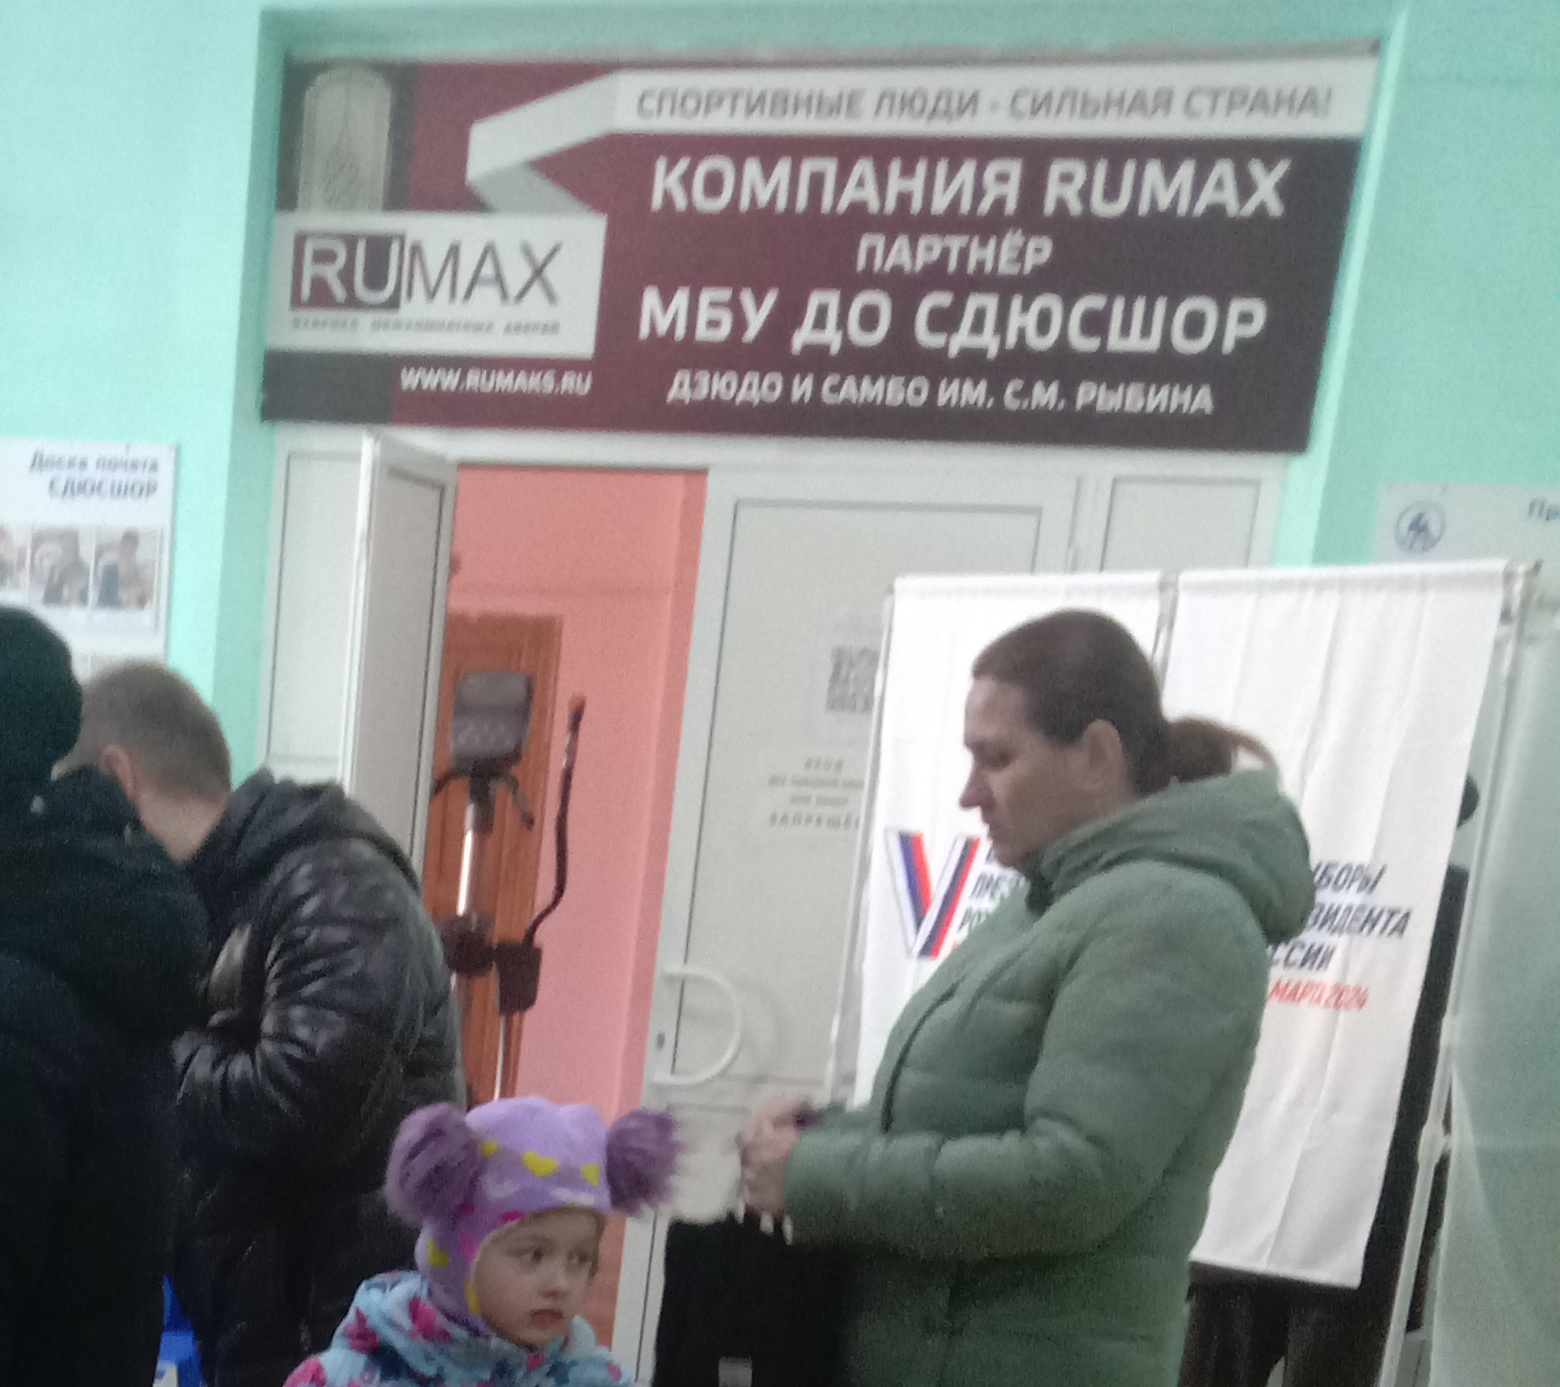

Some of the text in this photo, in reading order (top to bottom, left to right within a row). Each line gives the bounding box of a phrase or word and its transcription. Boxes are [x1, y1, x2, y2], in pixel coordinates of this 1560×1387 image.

[636, 86, 867, 120] СПОРТИВНЫЕ
[871, 87, 981, 124] ЛЮДИ
[1009, 85, 1176, 120] СИЛЬНАЯ
[1183, 84, 1334, 120] СТРАНА!
[650, 154, 1292, 219] КОМПАНИЯ RUMAX
[300, 236, 564, 307] RUMAX
[855, 227, 1054, 275] ПАРТНЁР
[638, 284, 1268, 360] МБУ ДО СДЮСШОР
[666, 368, 784, 407] ДЗЮДО
[791, 372, 815, 404] И
[821, 373, 931, 407] САМБО
[937, 376, 995, 409] ИМ.
[1075, 380, 1215, 415] РЫБИНА
[1306, 902, 1414, 939] ЗИДЕНТА
